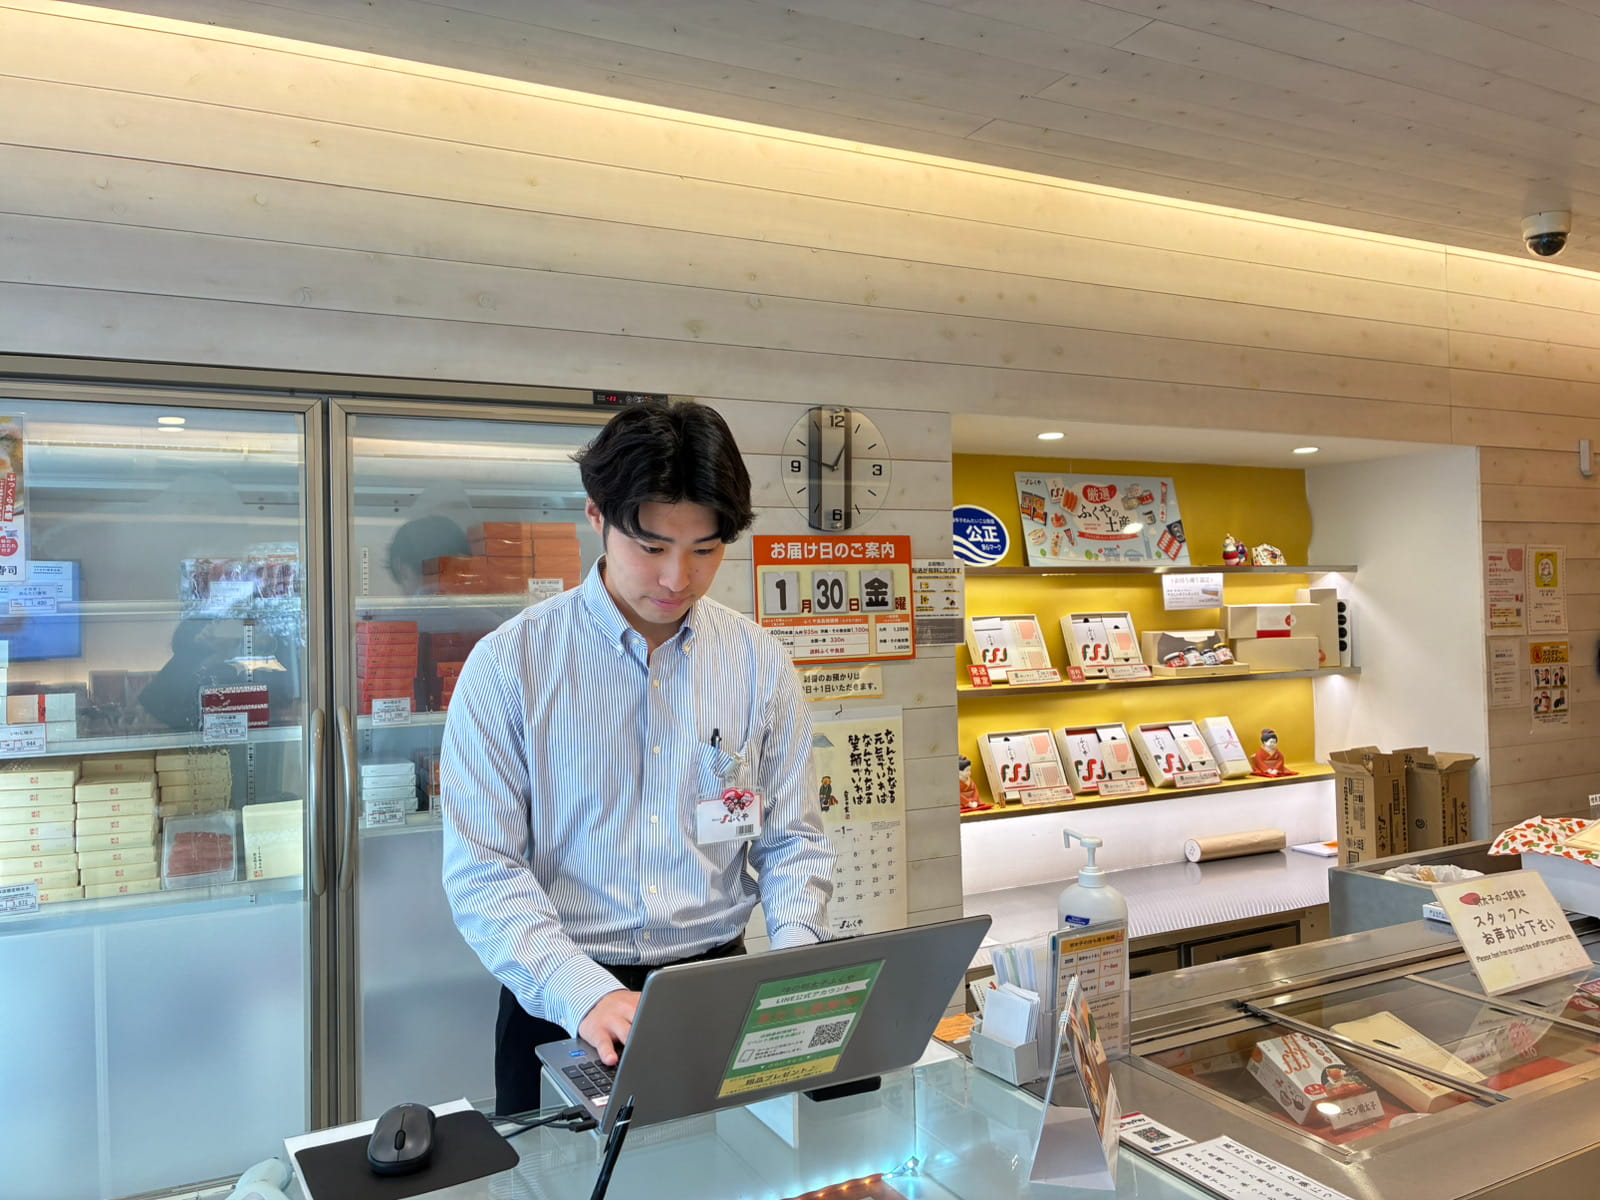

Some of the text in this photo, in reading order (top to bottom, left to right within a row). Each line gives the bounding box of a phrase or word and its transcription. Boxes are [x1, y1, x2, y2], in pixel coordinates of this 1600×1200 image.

[830, 415, 845, 428] 12
[791, 460, 801, 472] 9
[872, 464, 882, 476] 3
[832, 508, 842, 522] 6
[966, 525, 1000, 542] 公正
[770, 542, 896, 560] お届け日のご案内
[776, 577, 907, 614] 1 月 30 日 金 曜
[848, 734, 865, 805] 笑顔でいれば
[862, 734, 873, 804] なんとかなる
[874, 732, 889, 804] 元気でいれば
[884, 728, 897, 804] なんとかなる
[1474, 908, 1530, 928] スタッフへ
[1482, 918, 1556, 945] お声かけ下さい
[776, 985, 850, 1004] LINE公式アカウント
[1337, 1100, 1377, 1118] ーモン明太子
